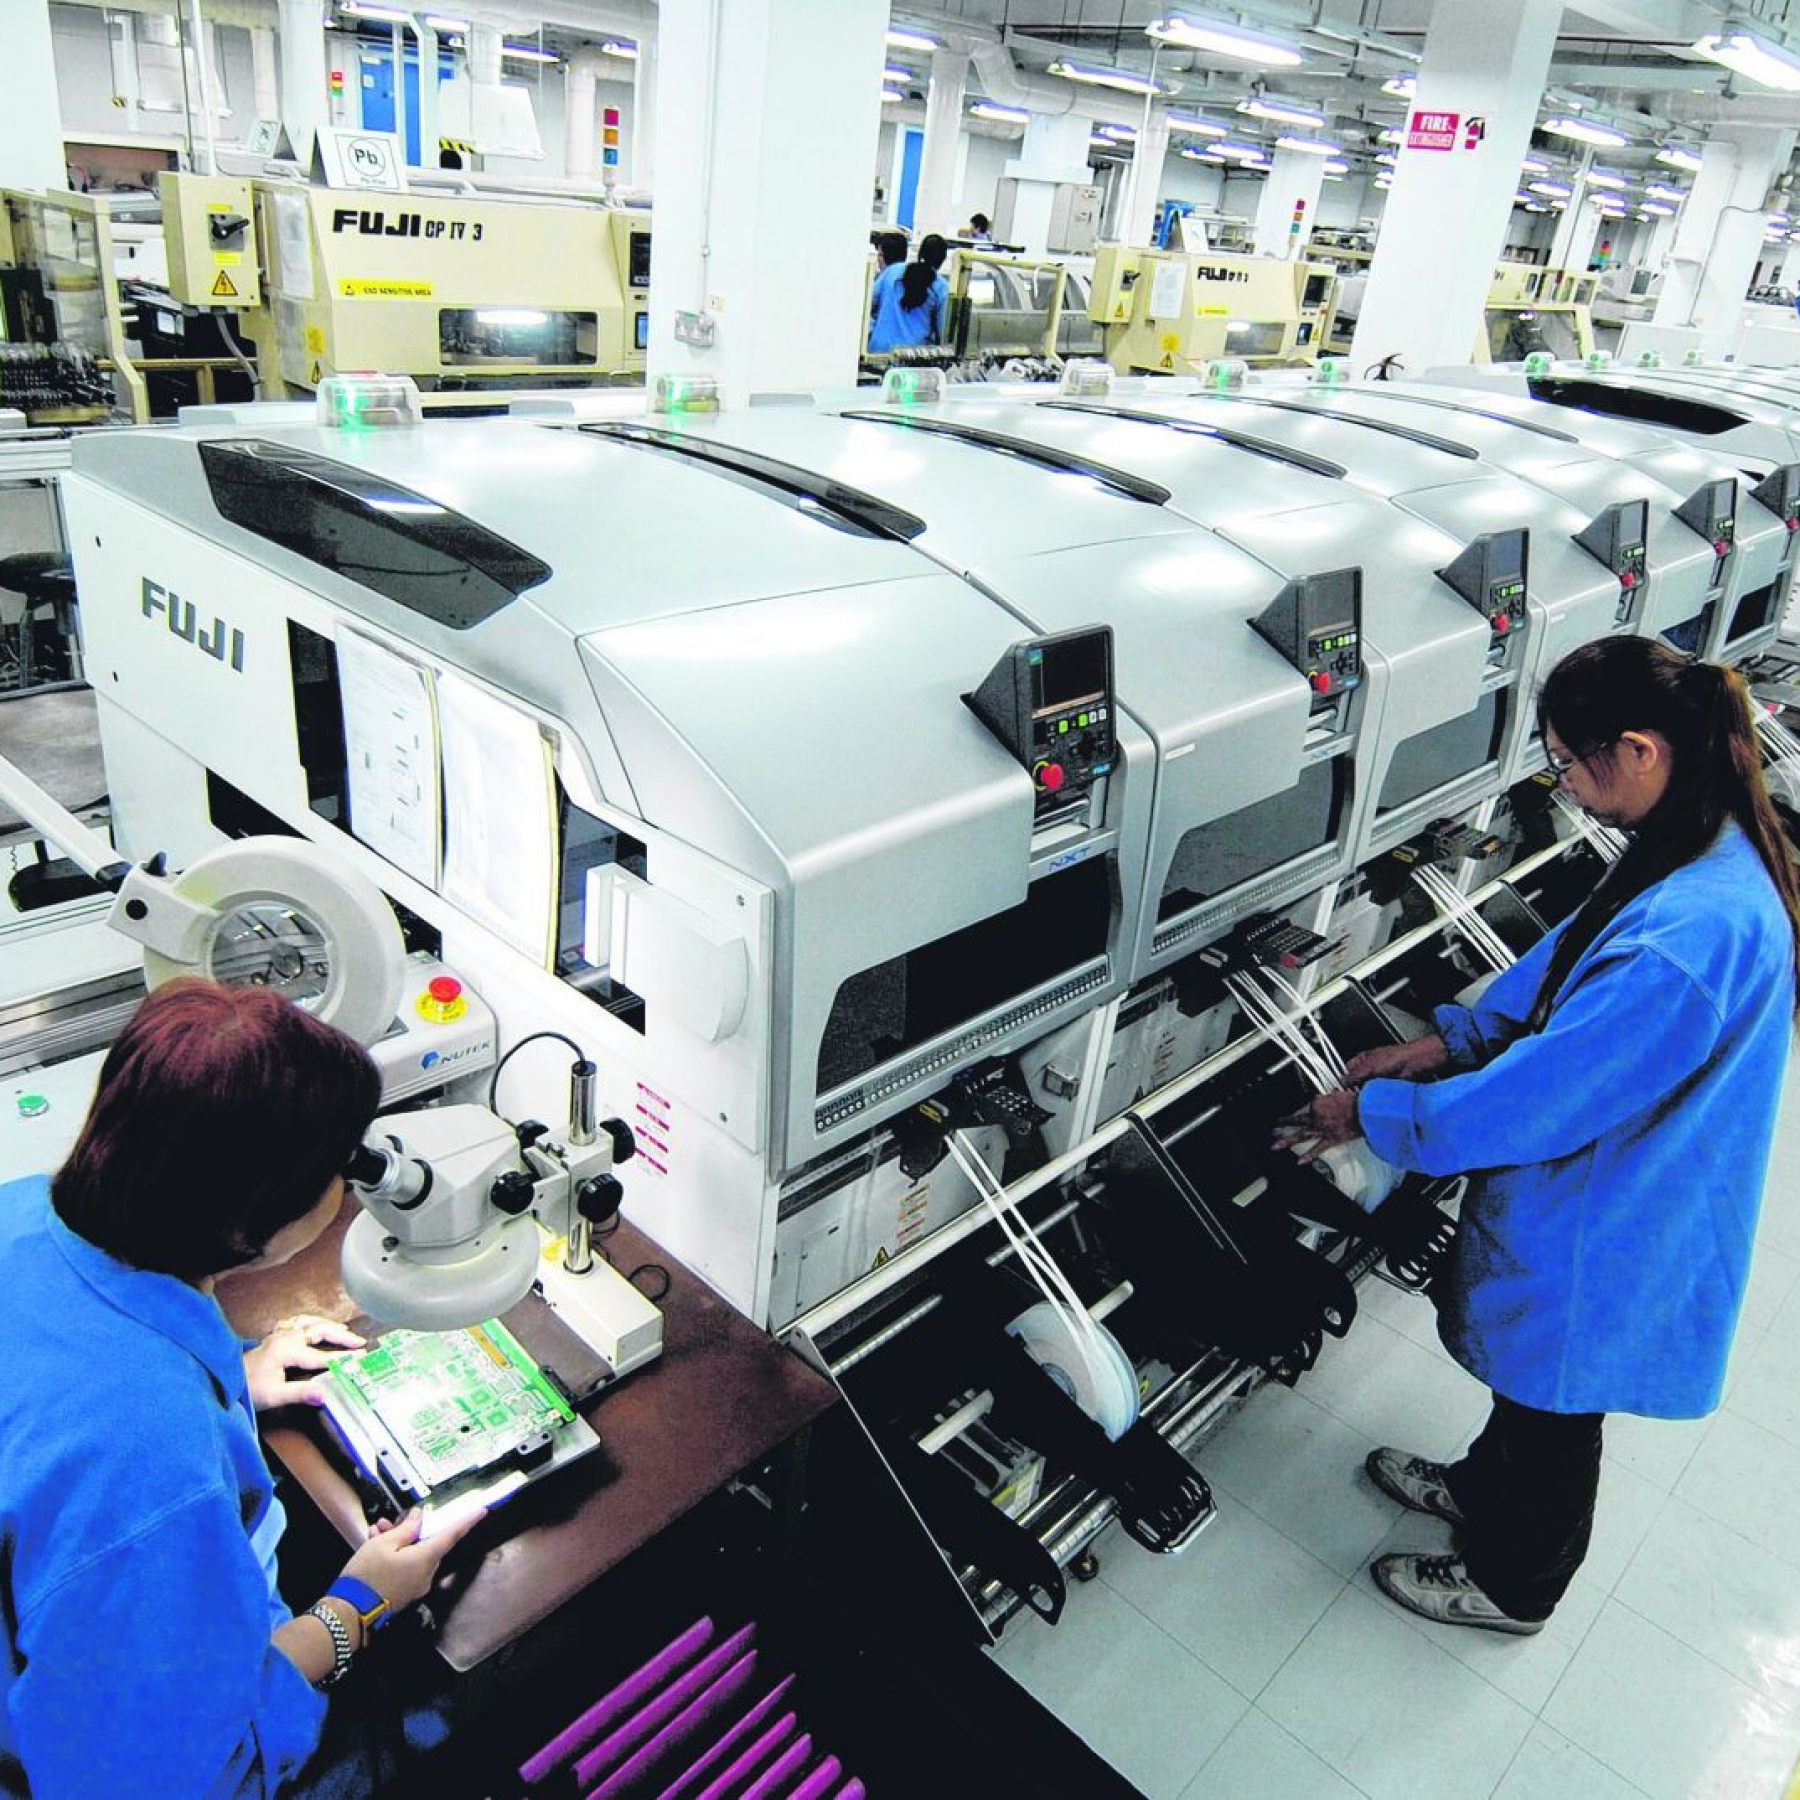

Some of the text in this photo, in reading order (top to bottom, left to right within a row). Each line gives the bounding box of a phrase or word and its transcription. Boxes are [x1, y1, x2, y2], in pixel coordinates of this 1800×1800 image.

[1420, 115, 1450, 132] FIRE
[355, 149, 378, 164] Pb
[333, 209, 483, 241] FUJI CP IV 3
[1197, 266, 1228, 281] FUJI
[142, 577, 244, 674] FUJI
[1049, 845, 1091, 871] NXT
[441, 1042, 490, 1064] NUTEK
